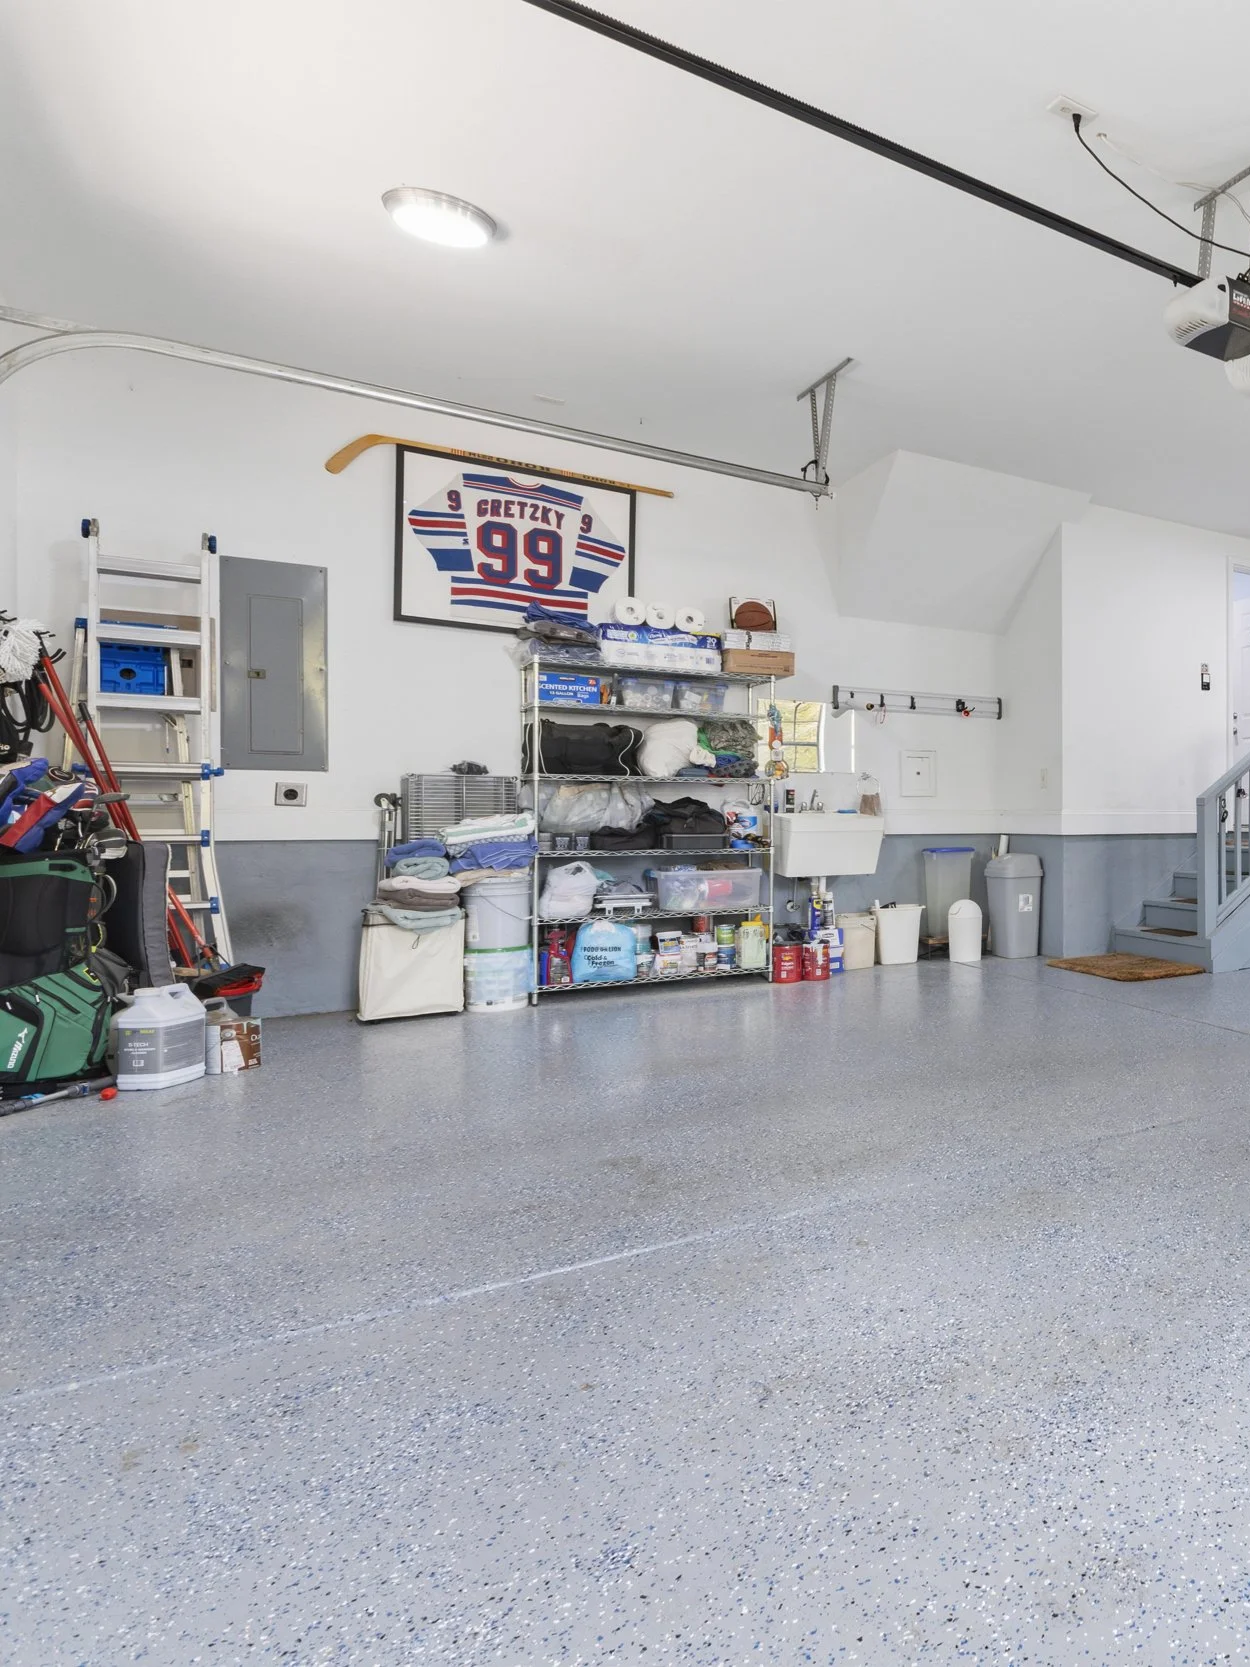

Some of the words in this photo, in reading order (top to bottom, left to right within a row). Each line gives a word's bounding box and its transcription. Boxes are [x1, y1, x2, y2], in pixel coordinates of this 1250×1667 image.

[447, 490, 462, 512] 9
[477, 499, 565, 530] GRETZKY
[580, 514, 593, 534] 9
[477, 520, 562, 590] 99
[569, 685, 598, 693] KITCHEN
